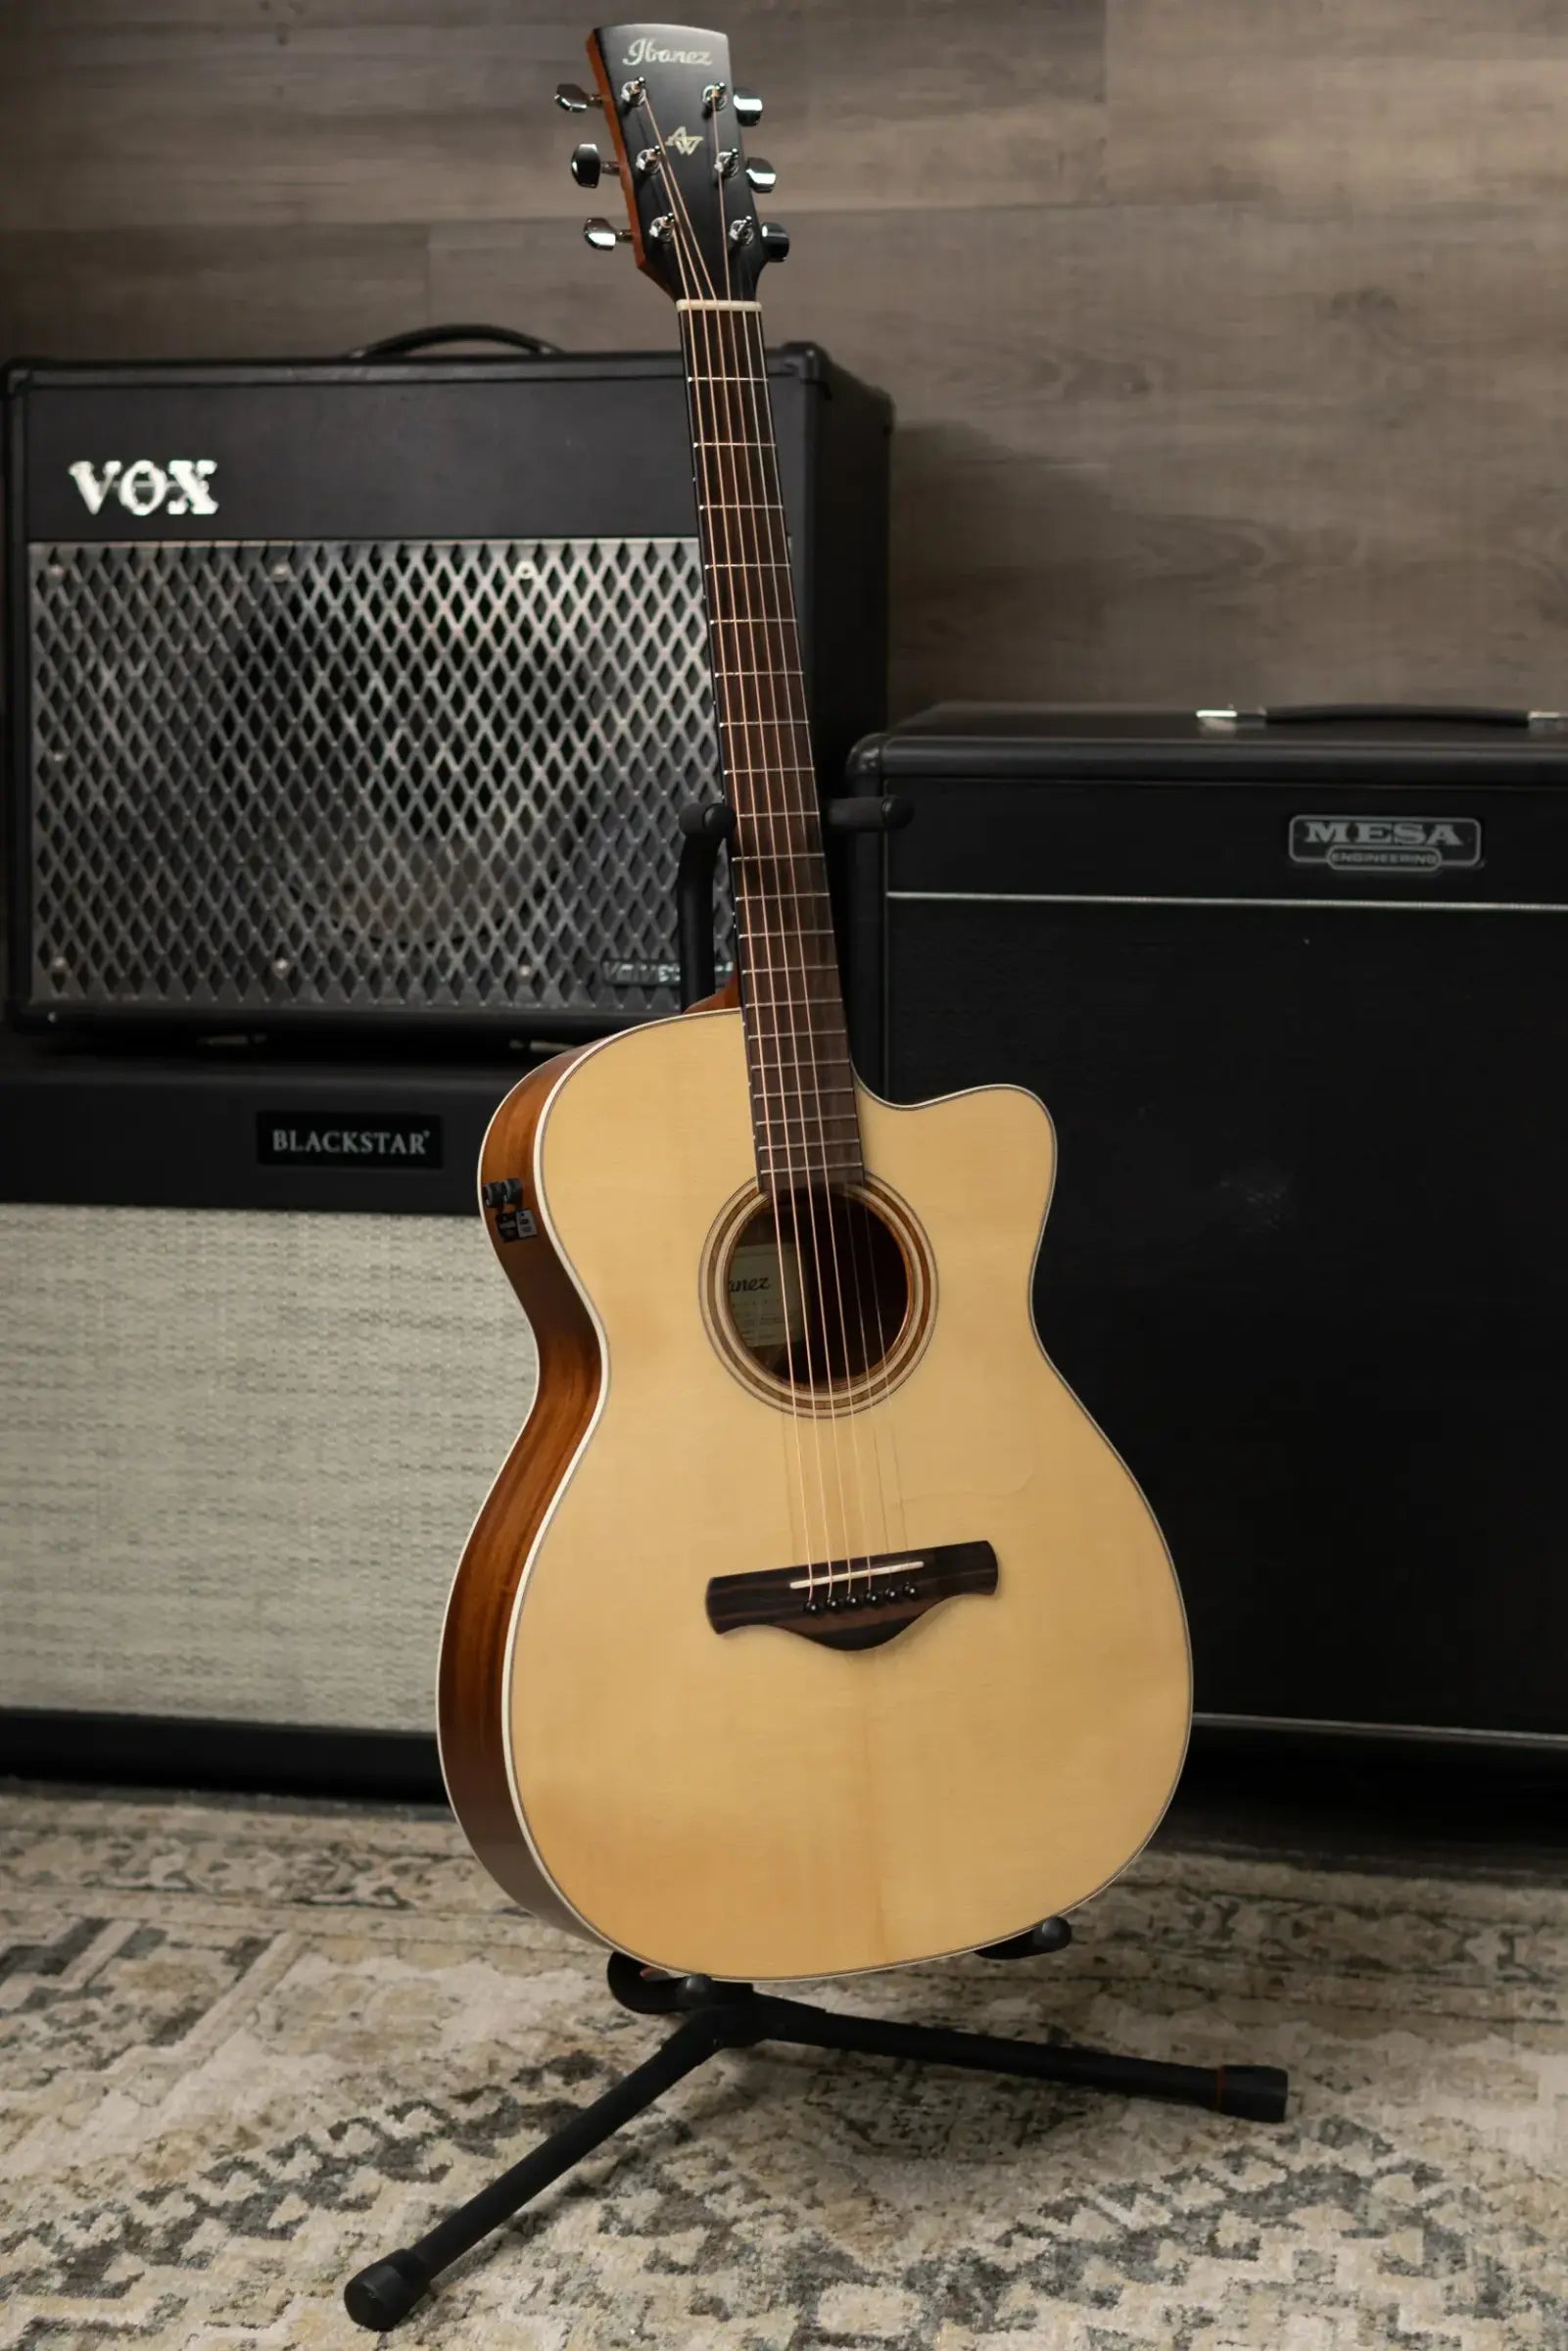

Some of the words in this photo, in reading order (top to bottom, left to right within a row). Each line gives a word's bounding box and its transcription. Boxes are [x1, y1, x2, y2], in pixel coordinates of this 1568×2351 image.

[622, 37, 713, 66] Ibanez
[69, 459, 219, 516] VOX
[1305, 821, 1464, 846] MESA
[1331, 852, 1437, 864] ENGINEERING
[272, 1128, 428, 1155] BLACKSTAR
[729, 1276, 771, 1292] anez
